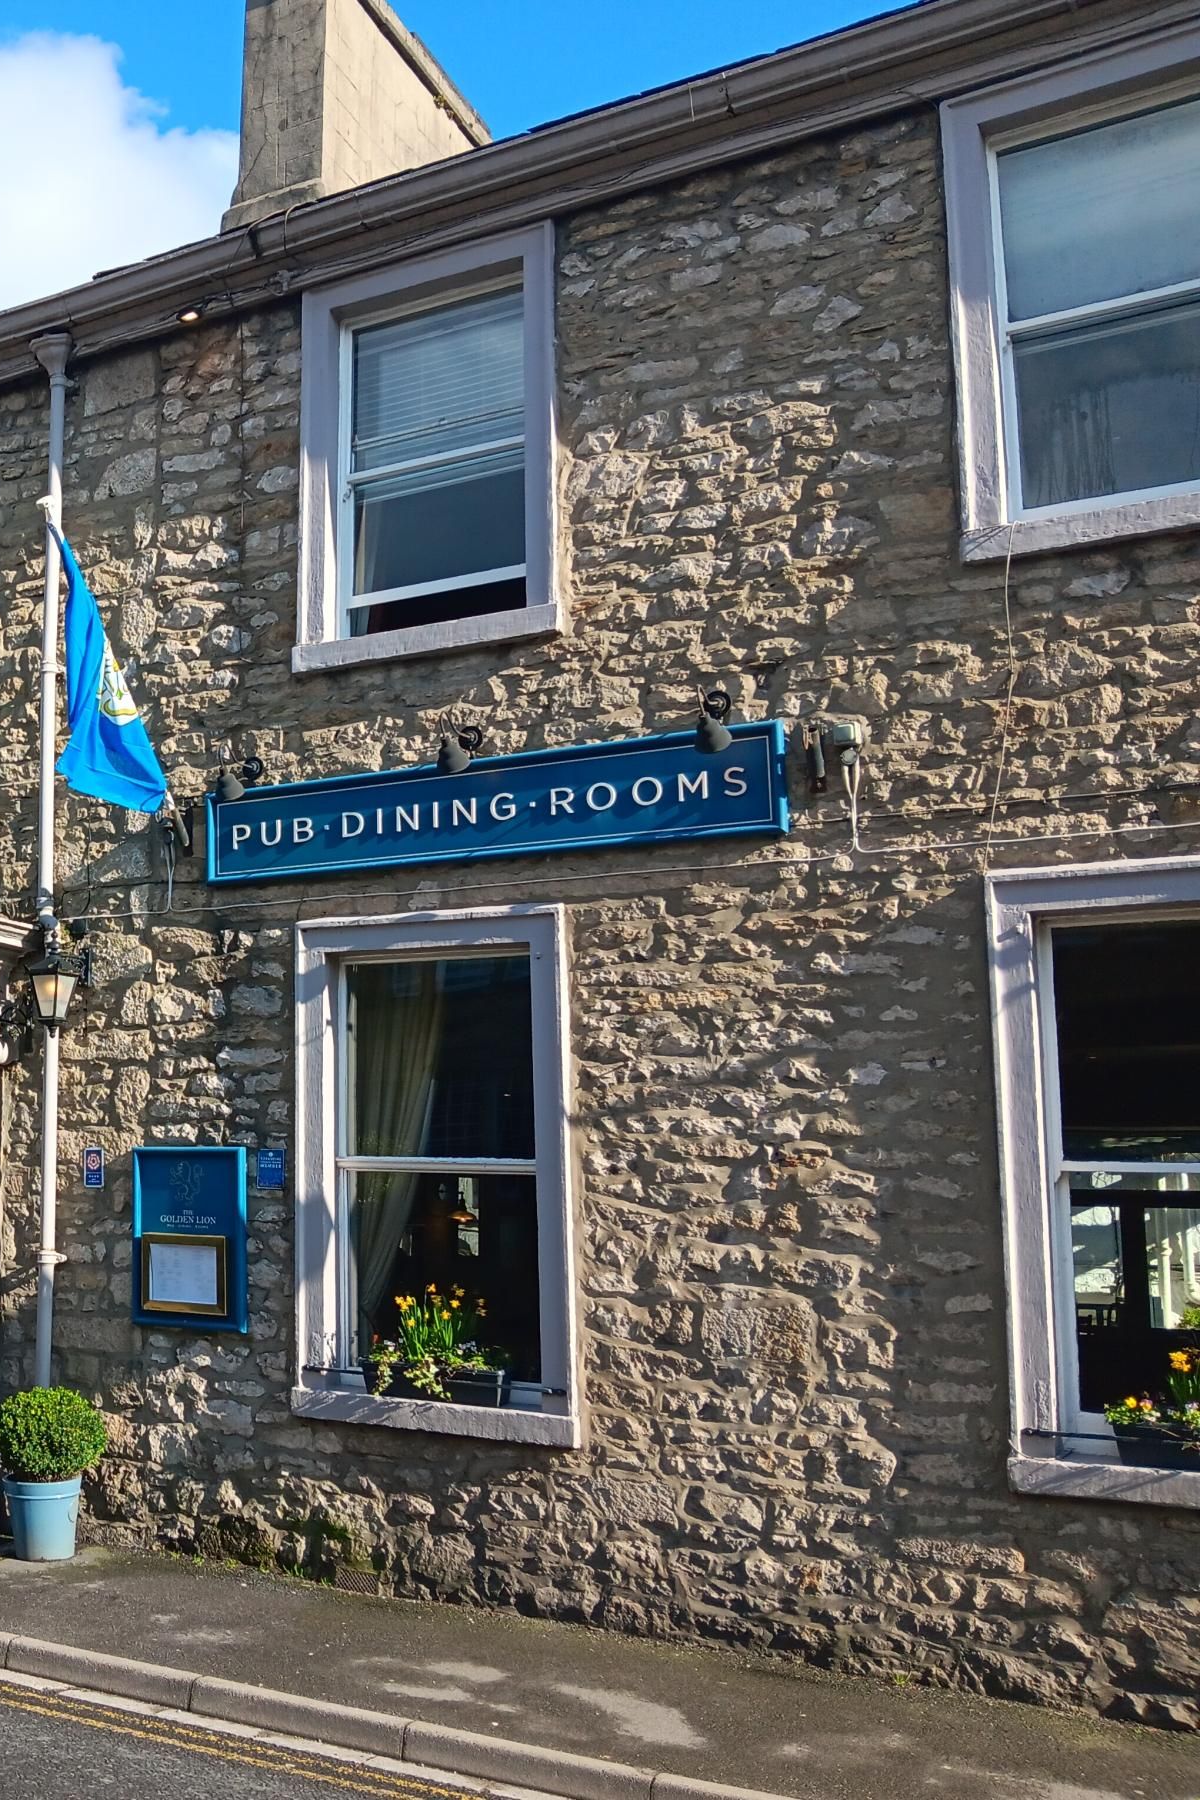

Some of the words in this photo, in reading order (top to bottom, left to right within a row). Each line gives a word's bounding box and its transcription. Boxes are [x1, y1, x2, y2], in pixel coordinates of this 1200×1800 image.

[231, 816, 315, 850] PUB
[160, 1214, 195, 1224] GOLDEN
[196, 1216, 217, 1225] LION
